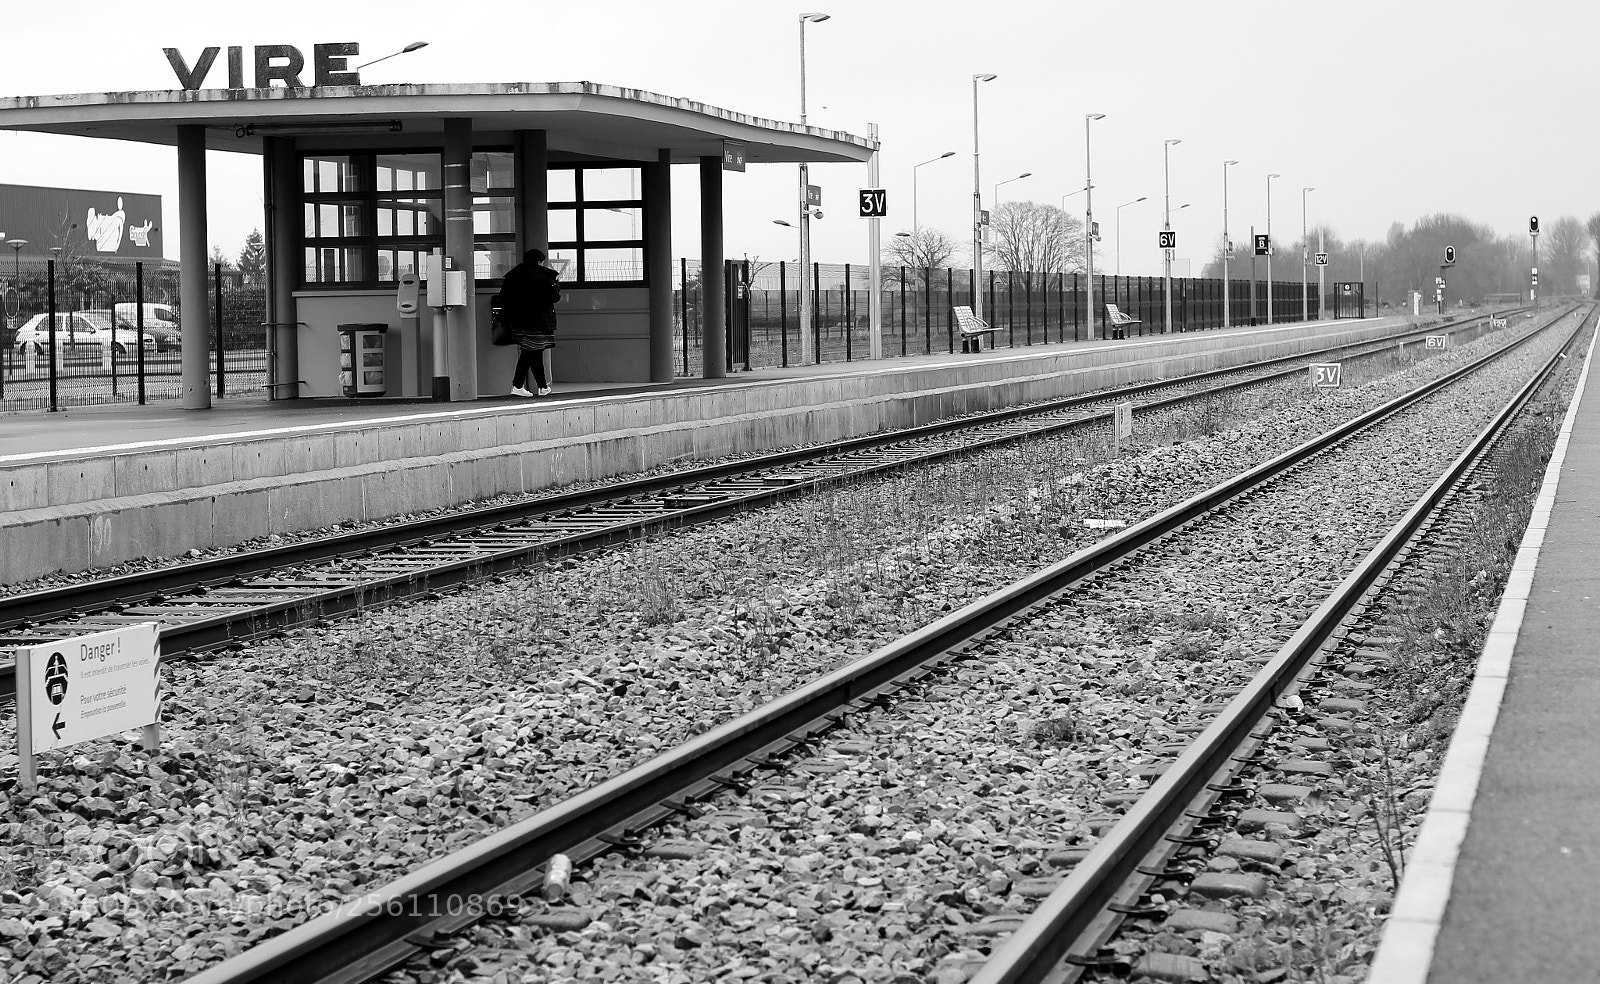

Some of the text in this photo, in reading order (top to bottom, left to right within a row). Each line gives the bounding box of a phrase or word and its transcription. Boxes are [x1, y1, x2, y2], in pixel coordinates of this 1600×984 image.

[162, 42, 360, 90] VIRE
[861, 193, 885, 213] 3V
[1160, 233, 1175, 246] 6V
[1316, 255, 1327, 264] 12V
[1428, 338, 1443, 347] 6V
[1317, 367, 1337, 383] 3V
[81, 643, 115, 662] Danger
[81, 684, 126, 705] Pour votre sécurité
